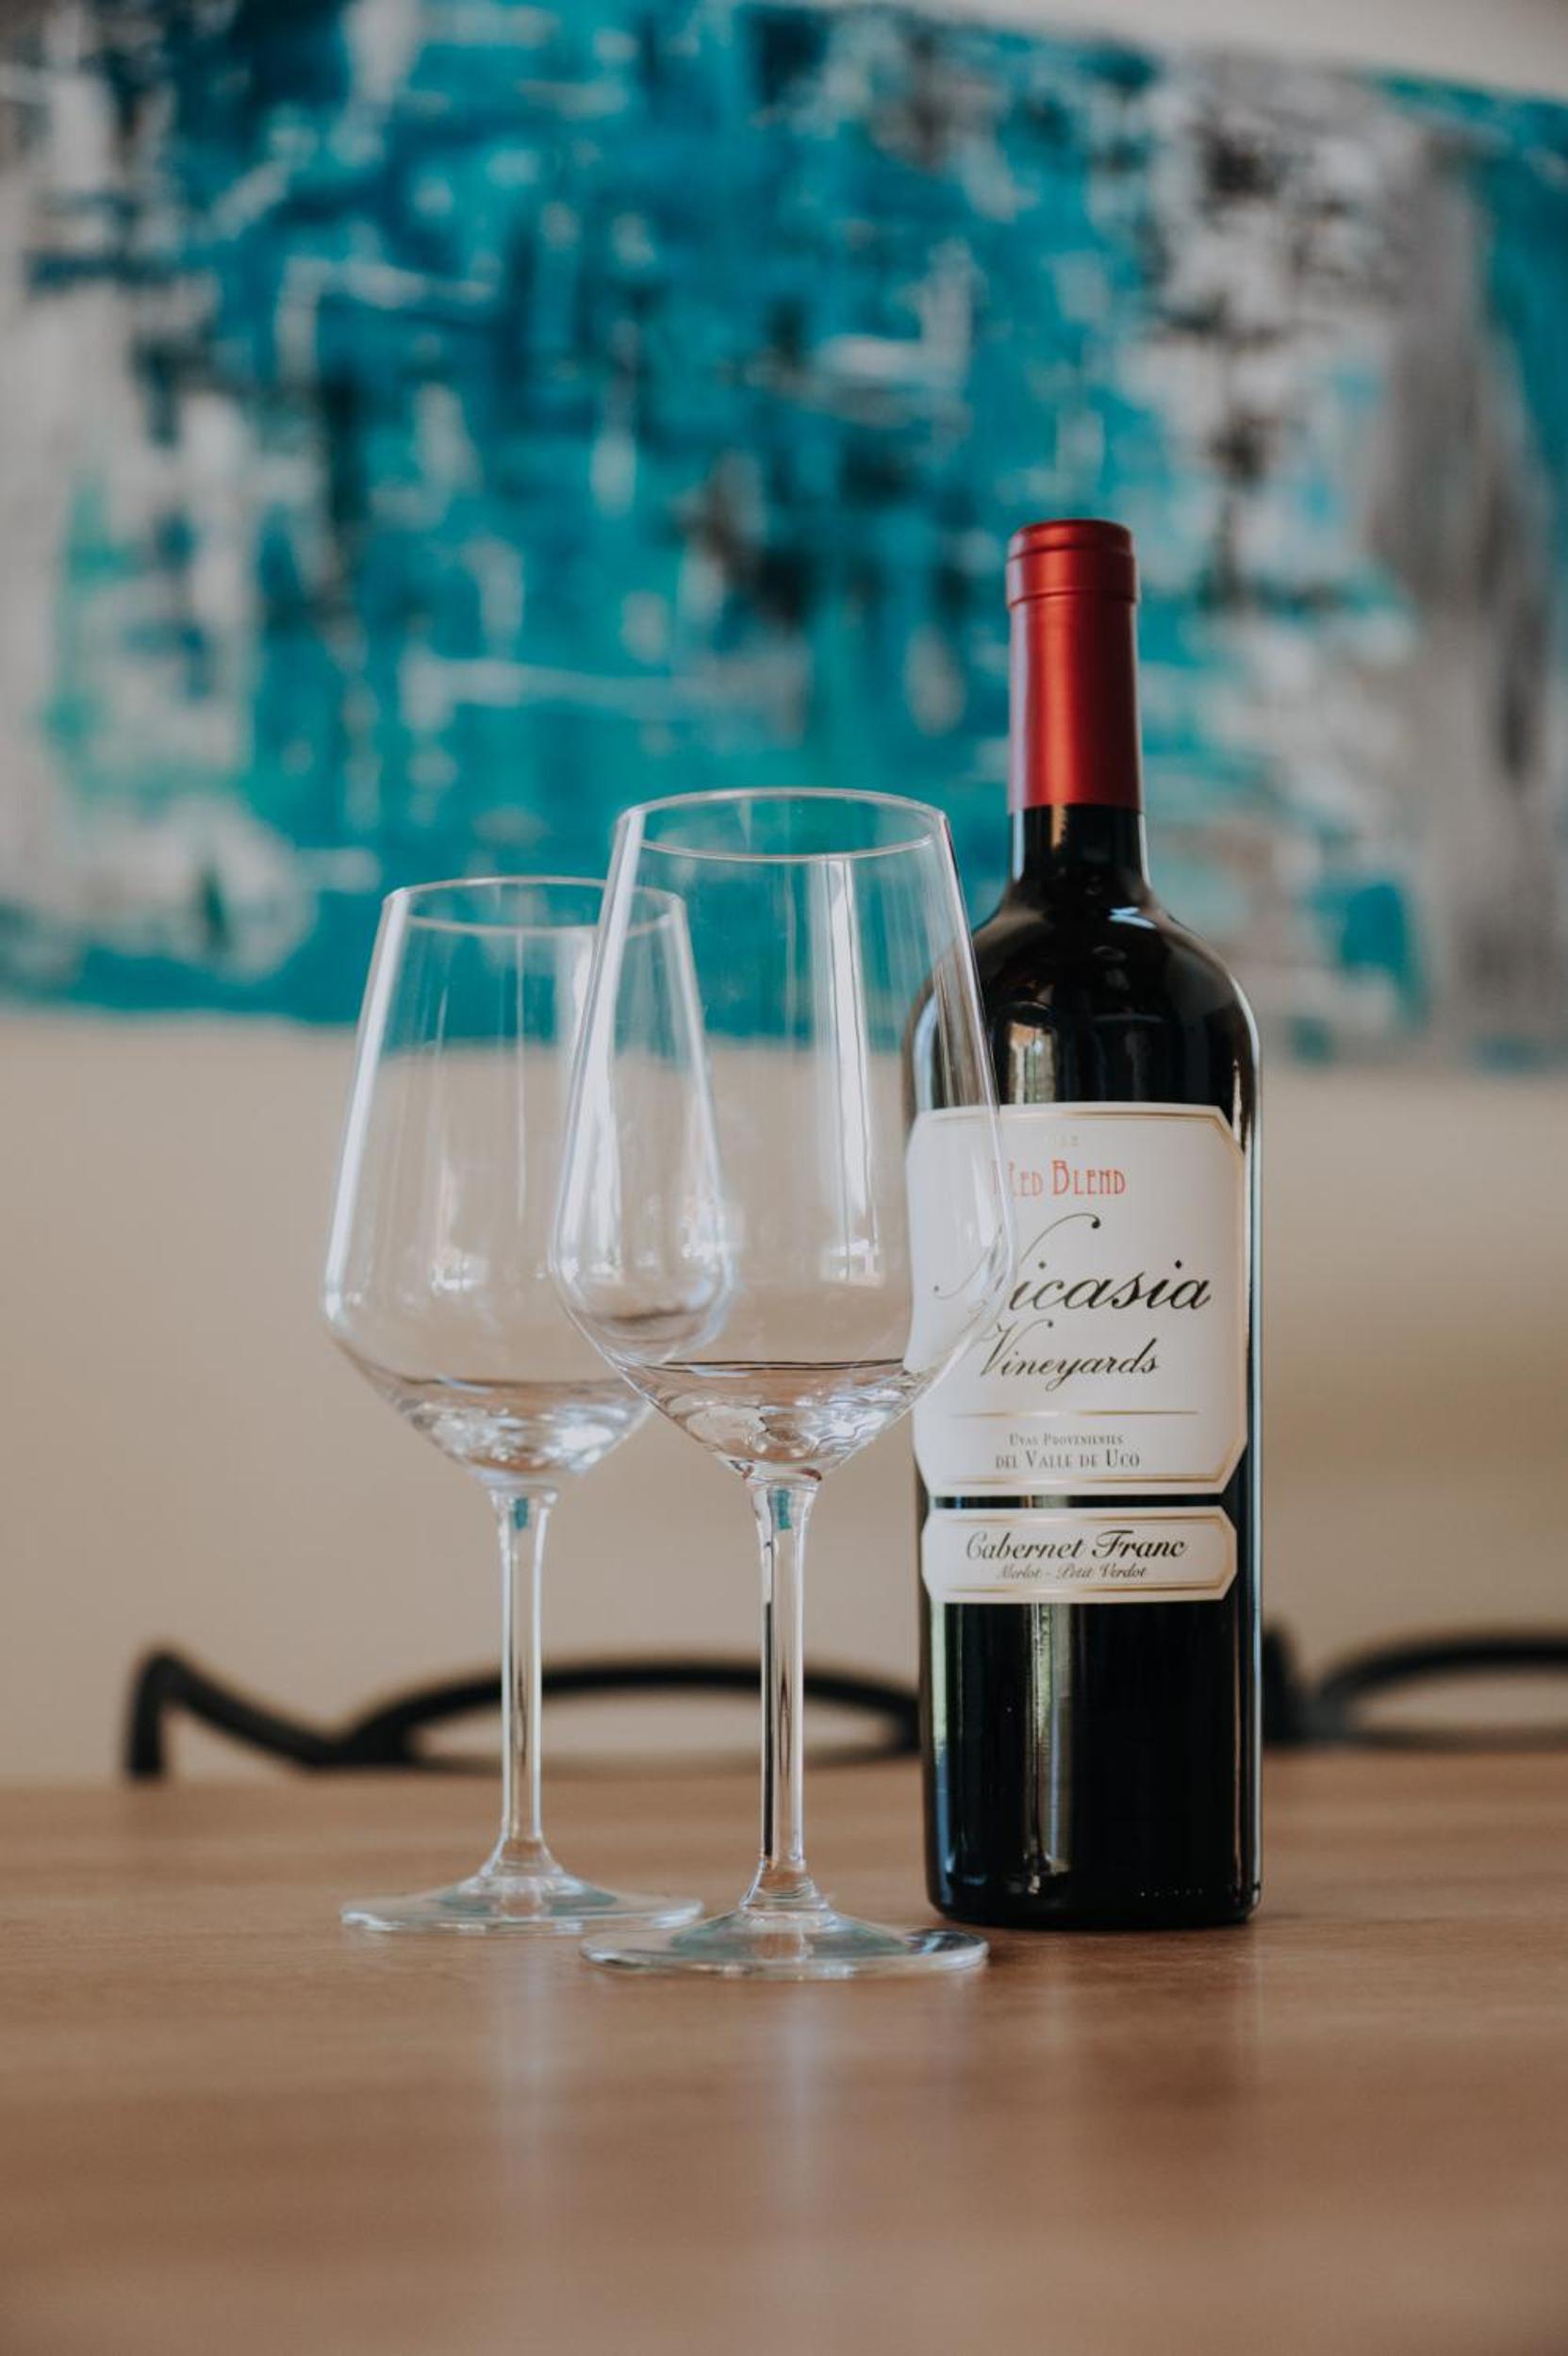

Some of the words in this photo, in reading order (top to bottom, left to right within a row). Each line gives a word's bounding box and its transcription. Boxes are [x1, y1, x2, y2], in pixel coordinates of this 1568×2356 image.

[980, 1319, 1162, 1392] Vineyards
[966, 1531, 1083, 1559] Cabernet
[1091, 1529, 1187, 1558] Franc
[1098, 1561, 1147, 1579] Verdot
